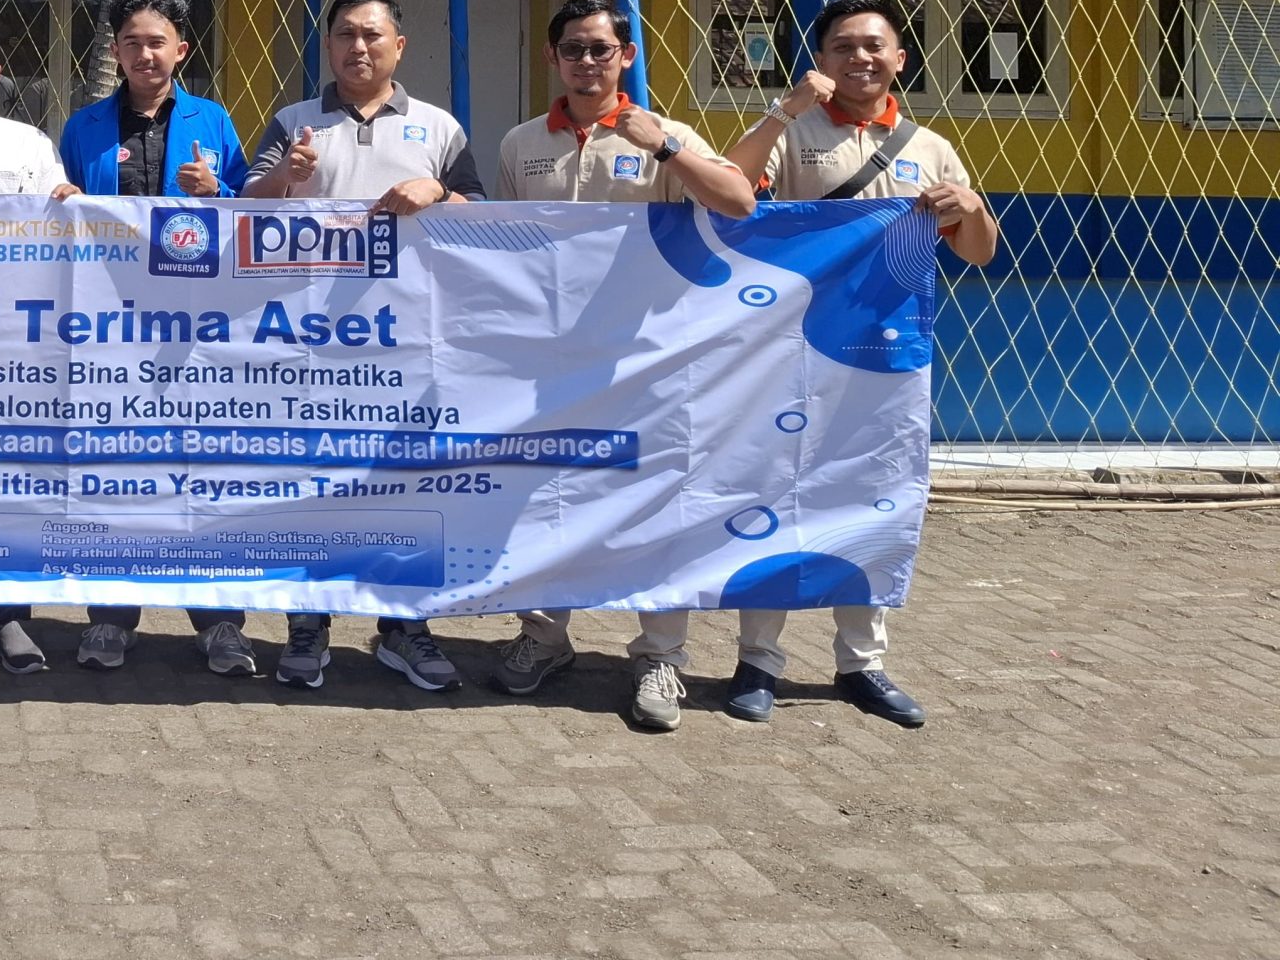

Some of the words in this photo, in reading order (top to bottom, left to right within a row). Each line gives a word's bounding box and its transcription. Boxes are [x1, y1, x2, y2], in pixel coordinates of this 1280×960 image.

[523, 157, 556, 165] KAMPUS
[523, 163, 555, 171] DIGITAL
[373, 214, 391, 275] UBSI
[158, 263, 210, 273] UNIVERSITAS
[14, 299, 231, 345] Terima
[252, 299, 398, 347] Aset
[68, 360, 129, 385] Bina
[138, 359, 234, 385] Sarana
[244, 361, 404, 388] Informatika
[122, 395, 272, 424] Kabupaten
[281, 396, 461, 430] Tasikmalaya
[63, 430, 174, 455] Chatbot
[182, 430, 307, 456] Berbasis
[315, 431, 437, 460] Artificial
[446, 434, 628, 461] Intelligence"
[81, 474, 158, 497] Dana
[168, 472, 301, 502] Yayasan
[311, 476, 406, 499] Tahun
[415, 472, 502, 495] 2025-
[41, 520, 109, 534] Anggota:
[216, 532, 265, 544] Herlan
[268, 531, 329, 547] Sutisna,
[332, 532, 361, 547] S.T,
[365, 533, 418, 547] M.Kom
[41, 547, 67, 558] Nur
[71, 547, 118, 559] Fathul
[121, 547, 154, 559] Alim
[158, 547, 223, 560] Budiman
[244, 548, 330, 561] Nurhalimah
[42, 563, 68, 577] Asy
[71, 563, 126, 577] Syaima
[189, 565, 265, 579] Mujahidah
